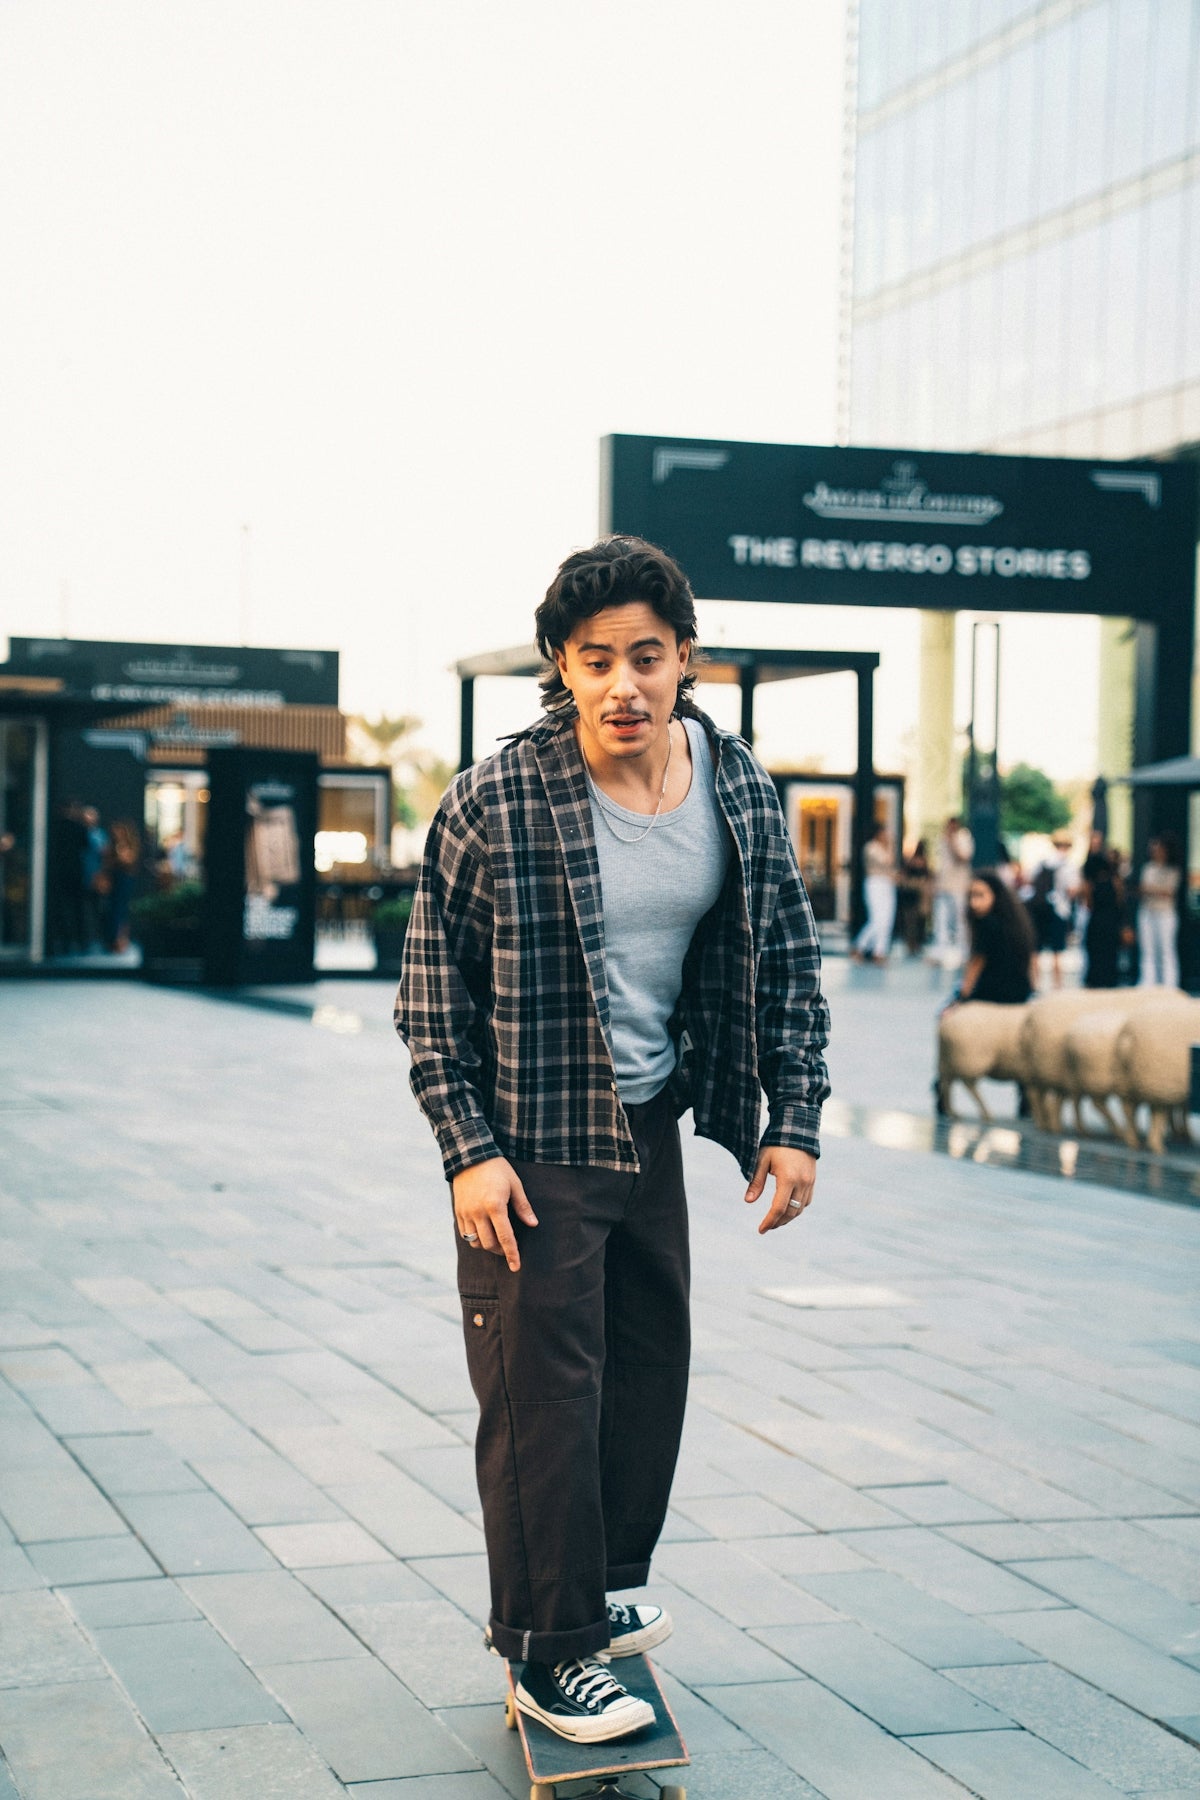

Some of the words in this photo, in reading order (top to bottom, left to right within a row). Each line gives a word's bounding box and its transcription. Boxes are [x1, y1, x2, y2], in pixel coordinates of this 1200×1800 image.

[730, 535, 796, 567] THE
[801, 538, 952, 574] REVERSO
[955, 545, 1091, 580] STORIES
